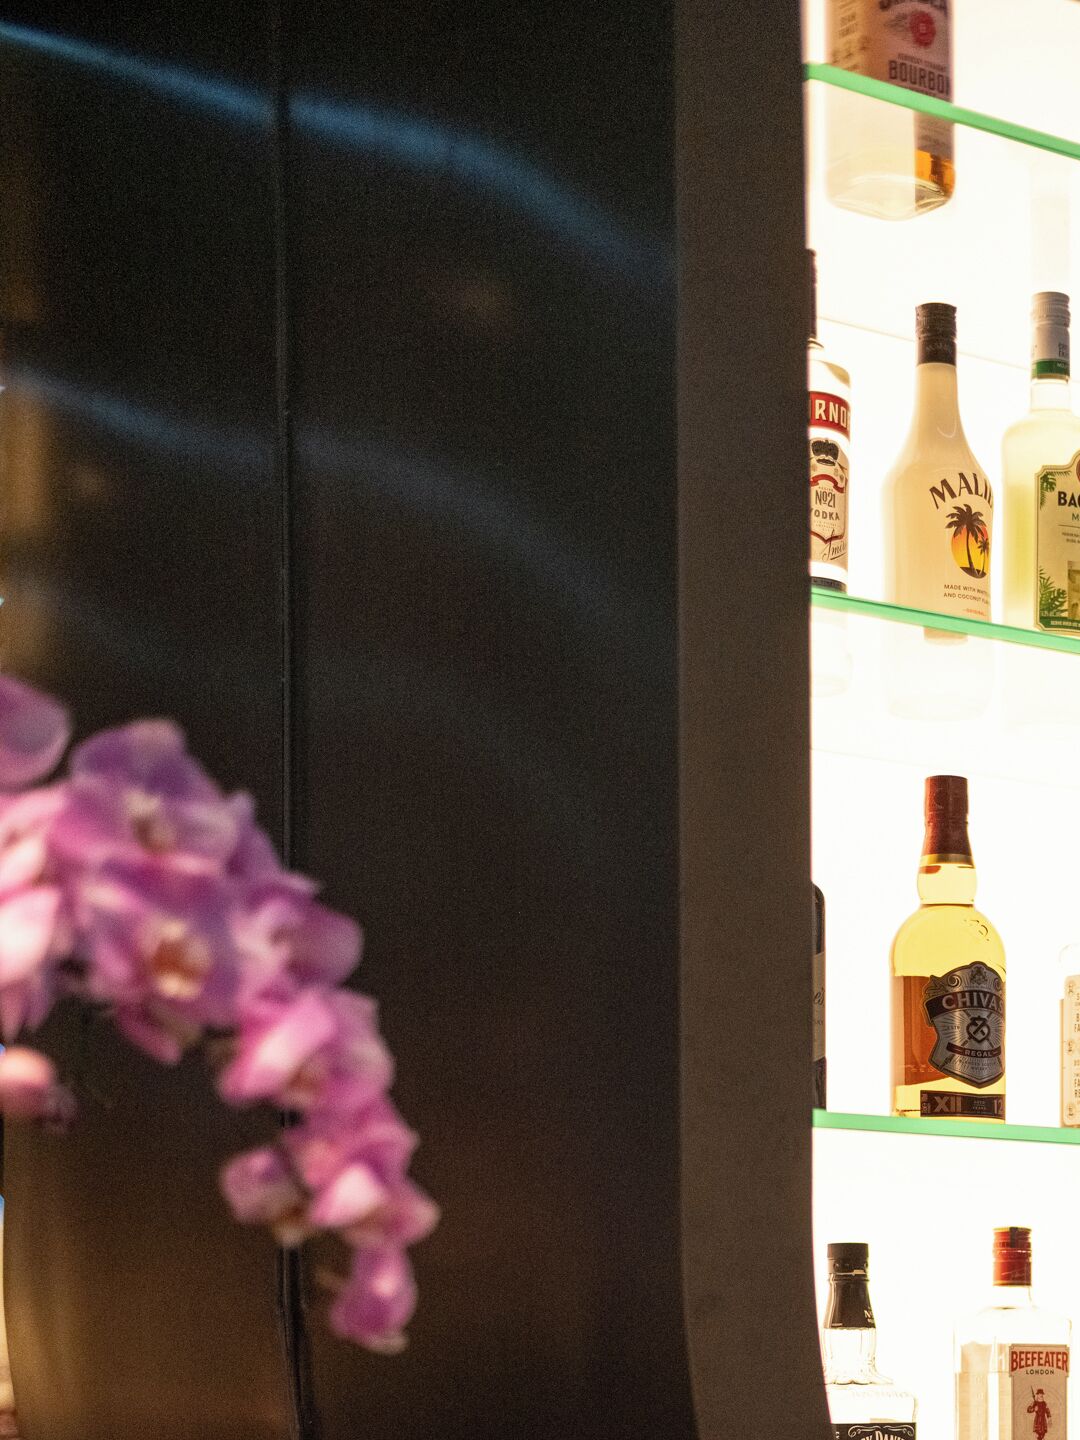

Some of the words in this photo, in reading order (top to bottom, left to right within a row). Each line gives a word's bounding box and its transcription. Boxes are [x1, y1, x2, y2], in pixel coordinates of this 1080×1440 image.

[964, 1050, 993, 1058] REGAL
[933, 1095, 962, 1113] XII
[1011, 1350, 1069, 1373] BEEFEATER
